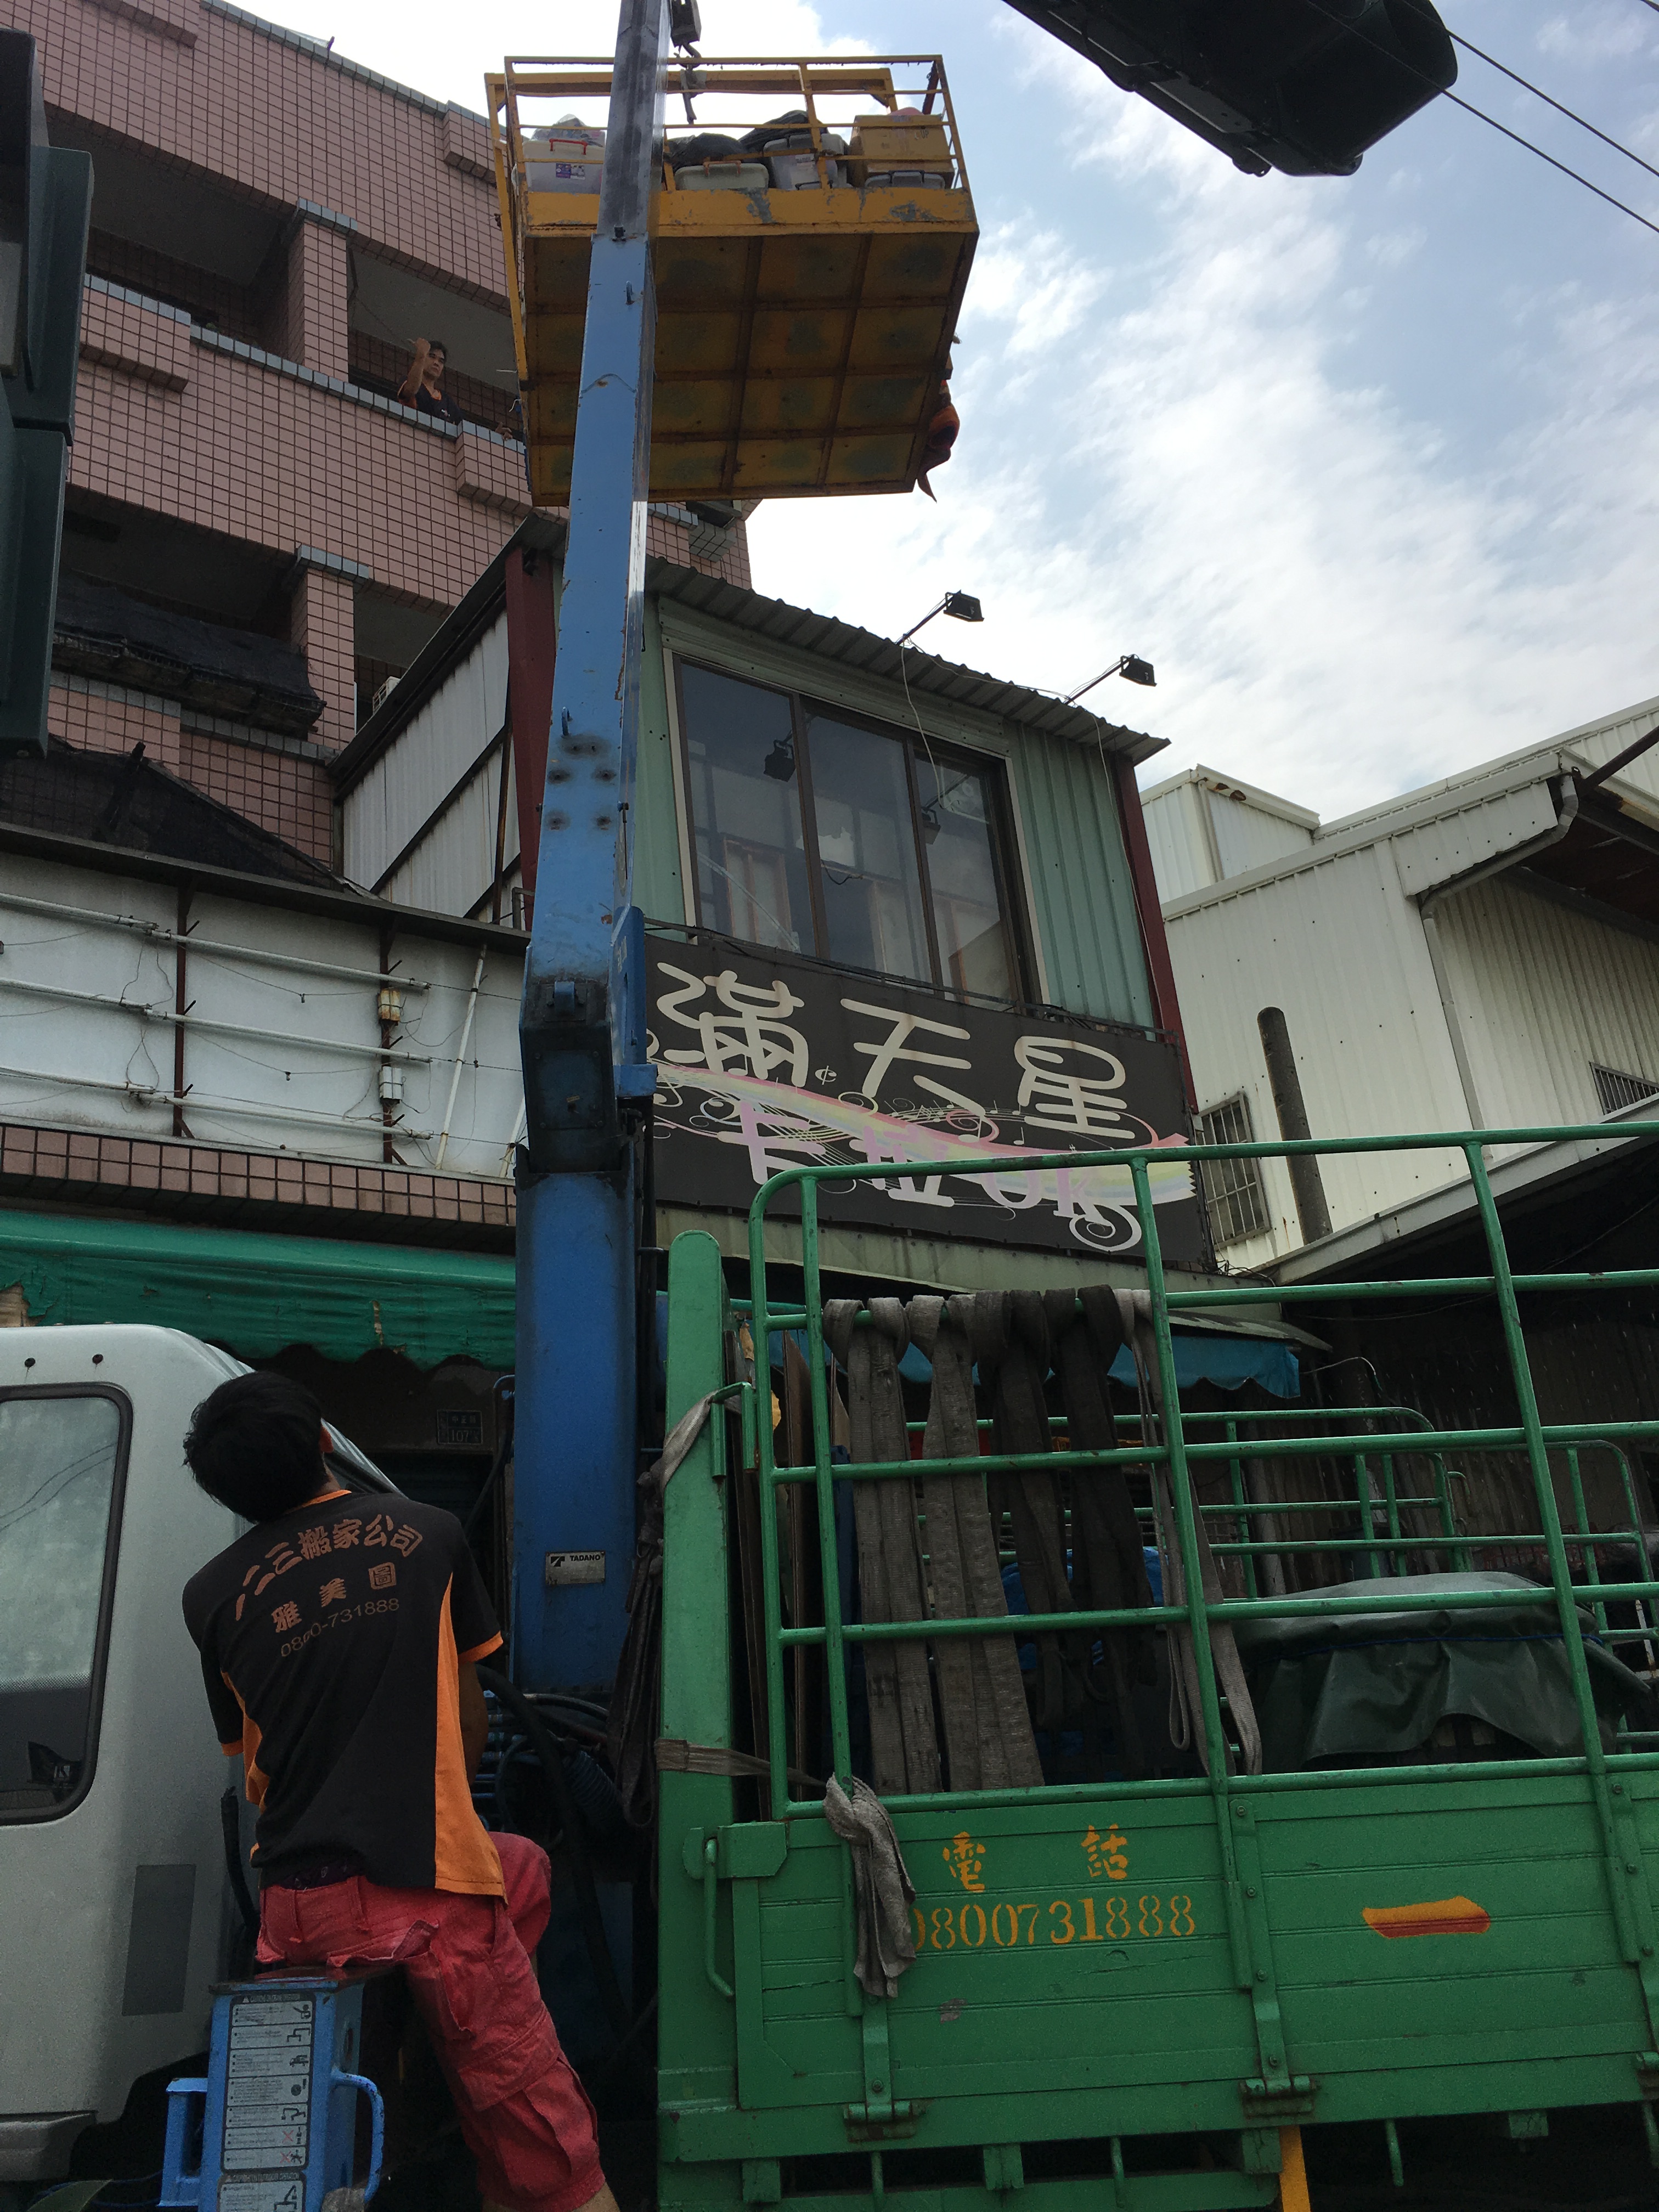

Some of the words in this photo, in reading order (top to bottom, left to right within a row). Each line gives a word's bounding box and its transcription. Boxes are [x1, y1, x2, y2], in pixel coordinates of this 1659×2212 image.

[657, 962, 1136, 1139] 滿天星
[236, 1514, 423, 1621] 一二三搬家公司
[271, 1562, 397, 1633] 雅美圖
[943, 1824, 1128, 1893] 電話
